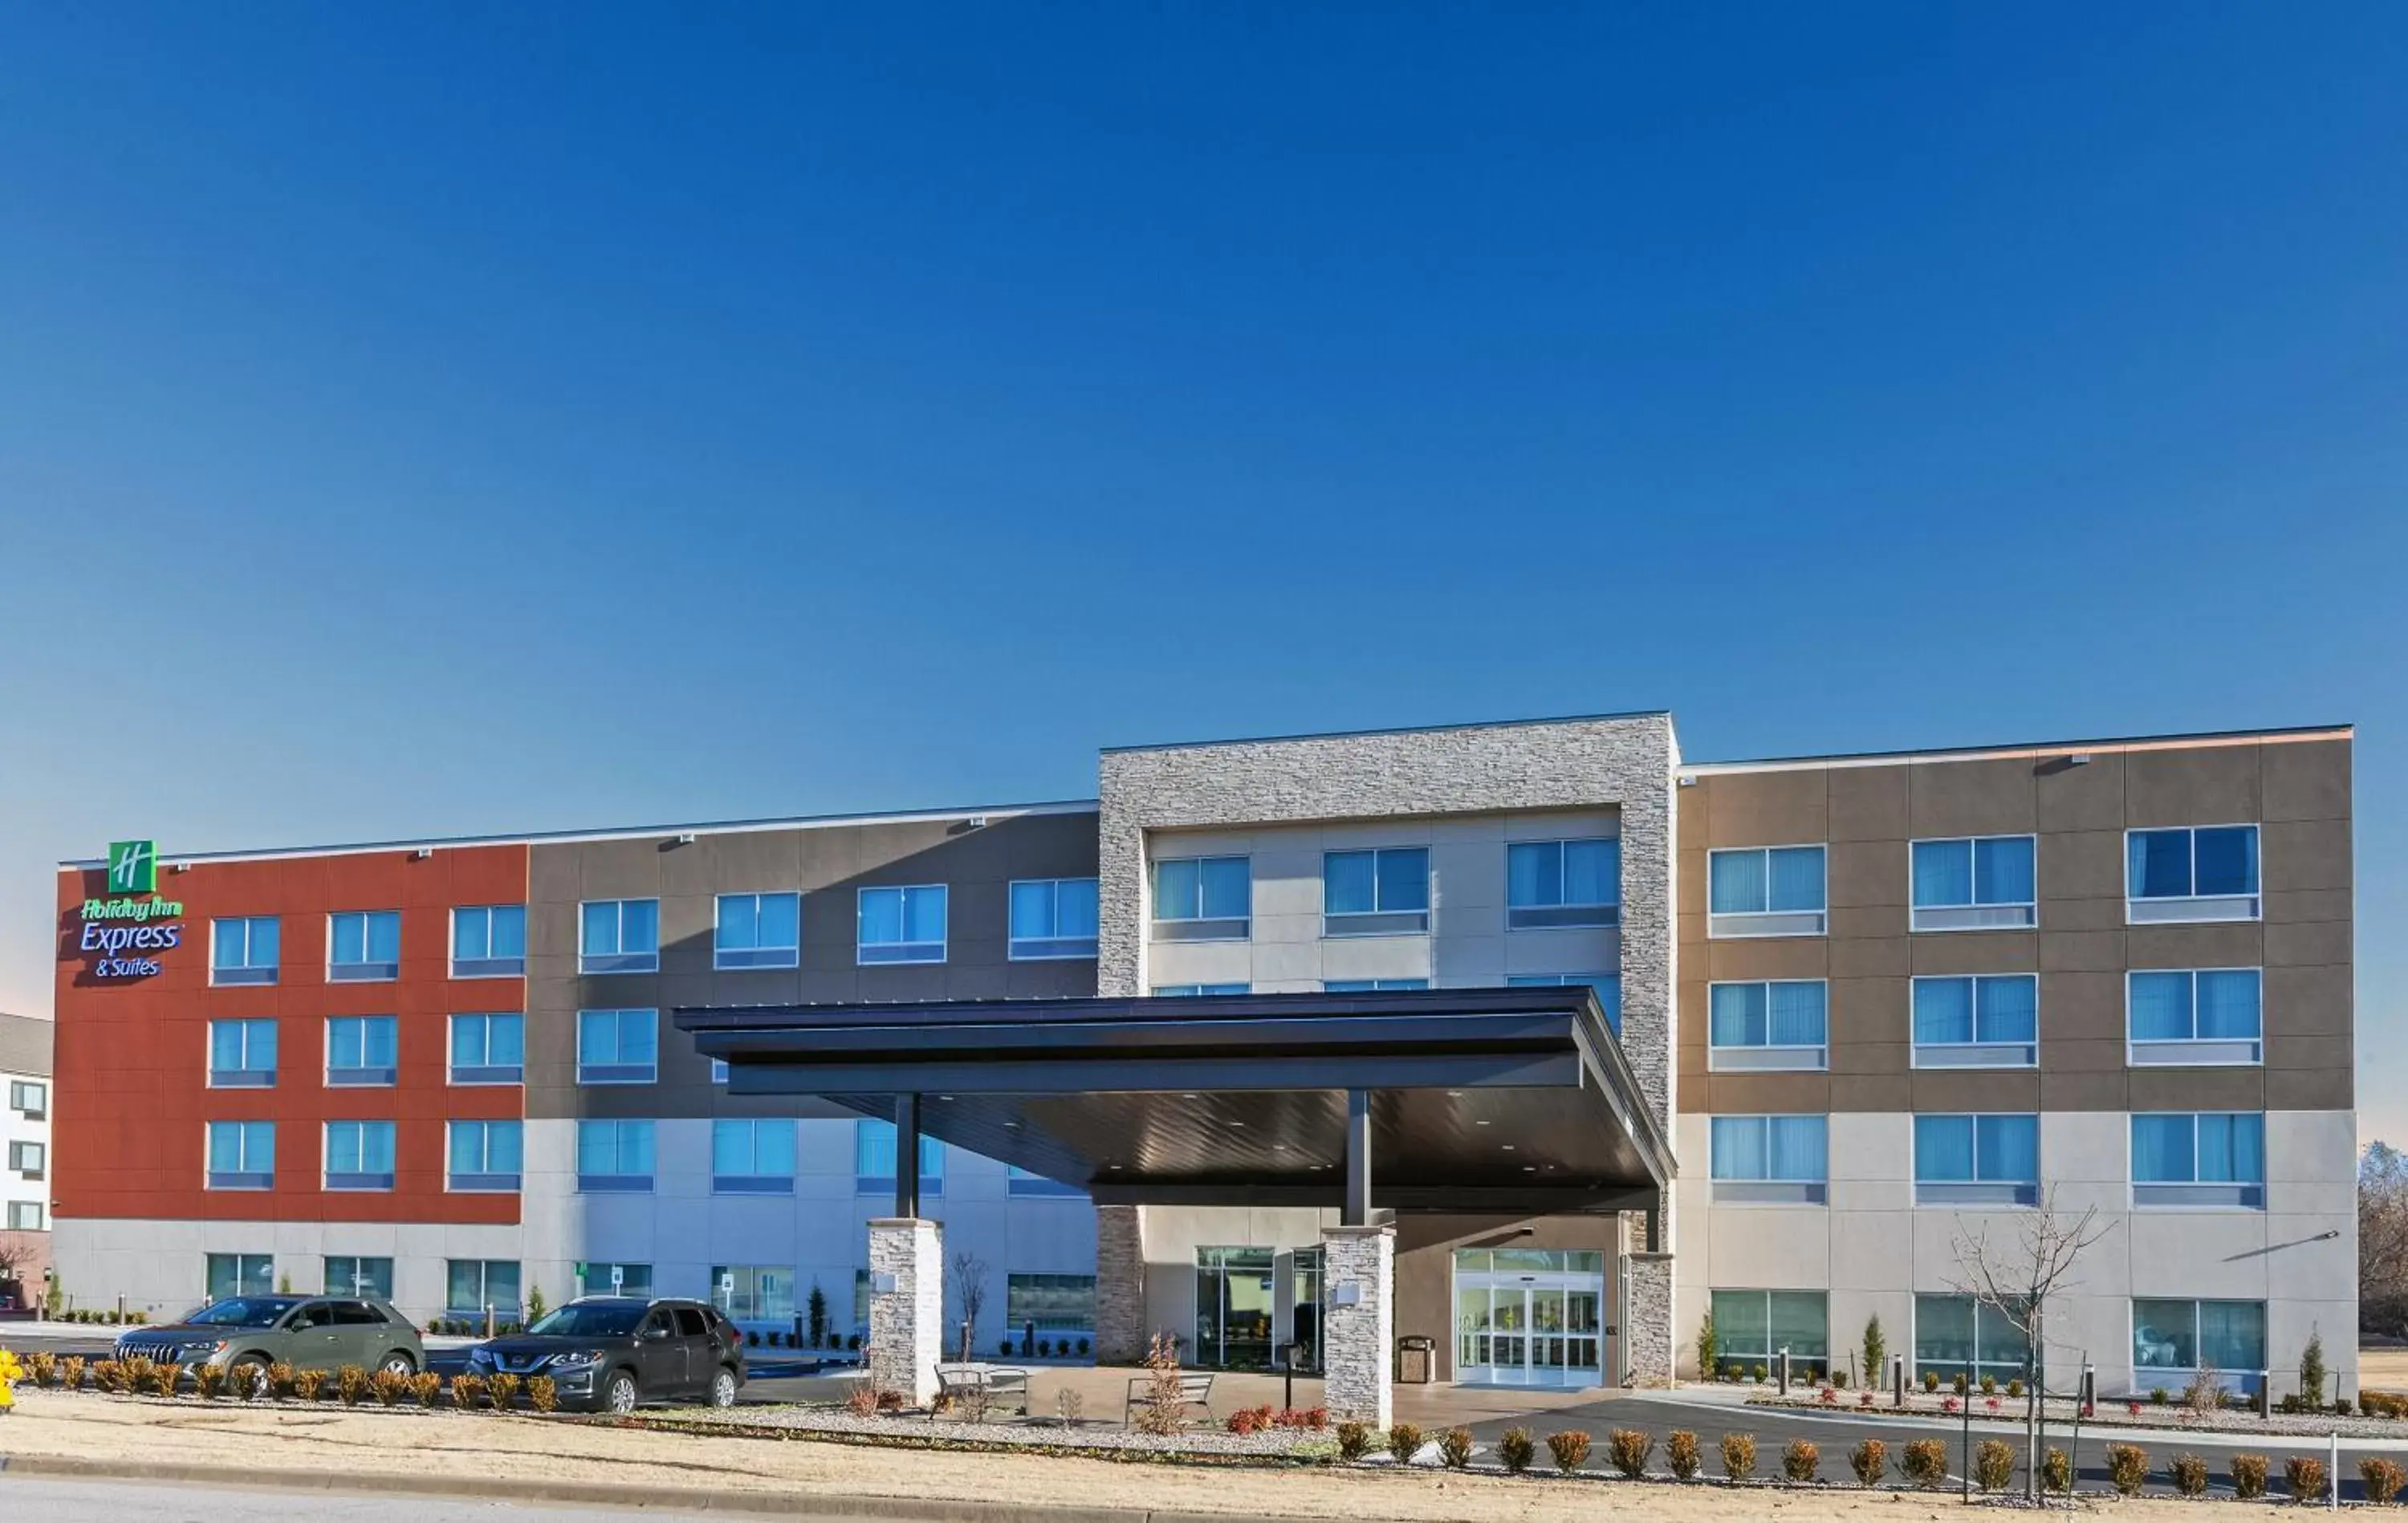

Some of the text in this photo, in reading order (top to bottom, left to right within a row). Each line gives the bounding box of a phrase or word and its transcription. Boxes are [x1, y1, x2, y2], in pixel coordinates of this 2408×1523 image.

[80, 896, 183, 922] Holiday Inn
[80, 922, 179, 956] Express
[96, 958, 159, 977] & Suites
